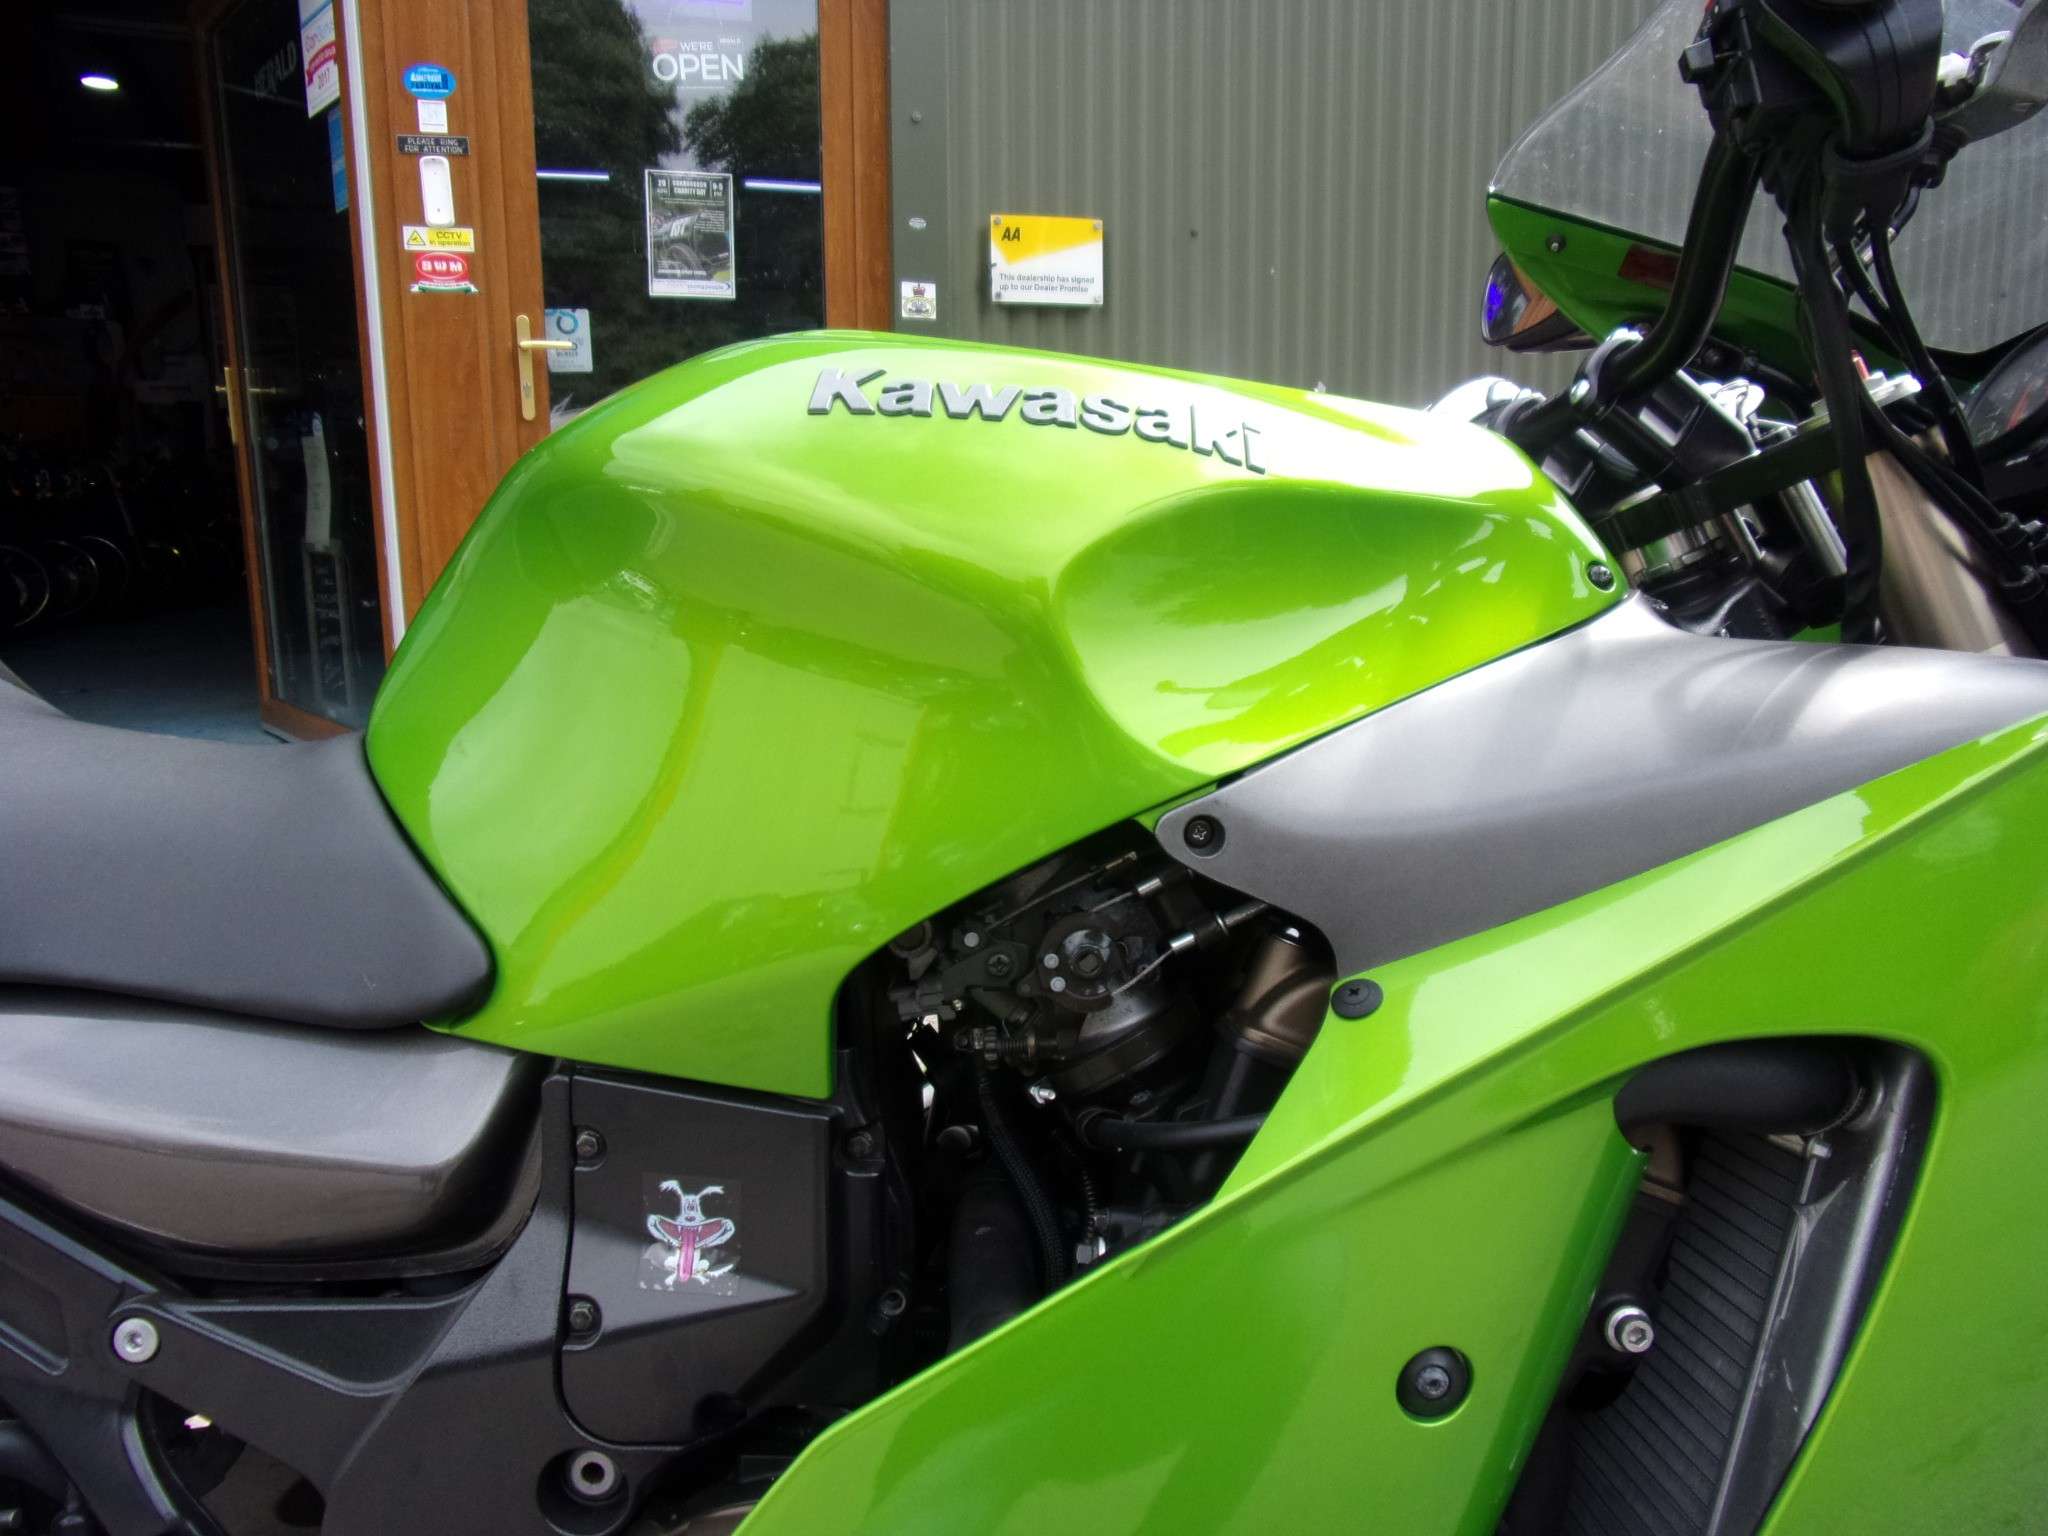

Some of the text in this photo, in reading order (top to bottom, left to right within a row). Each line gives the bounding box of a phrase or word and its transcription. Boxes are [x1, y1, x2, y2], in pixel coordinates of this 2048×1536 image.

[652, 53, 744, 81] OPEN
[423, 145, 463, 154] ATTENTION
[436, 231, 462, 240] CCTV
[1001, 227, 1021, 241] AA
[1000, 273, 1094, 284] This dealership has signed
[1000, 284, 1009, 292] up
[1034, 283, 1058, 292] Dealer
[1060, 285, 1089, 293] Promise
[807, 367, 1266, 475] Kawasaki
